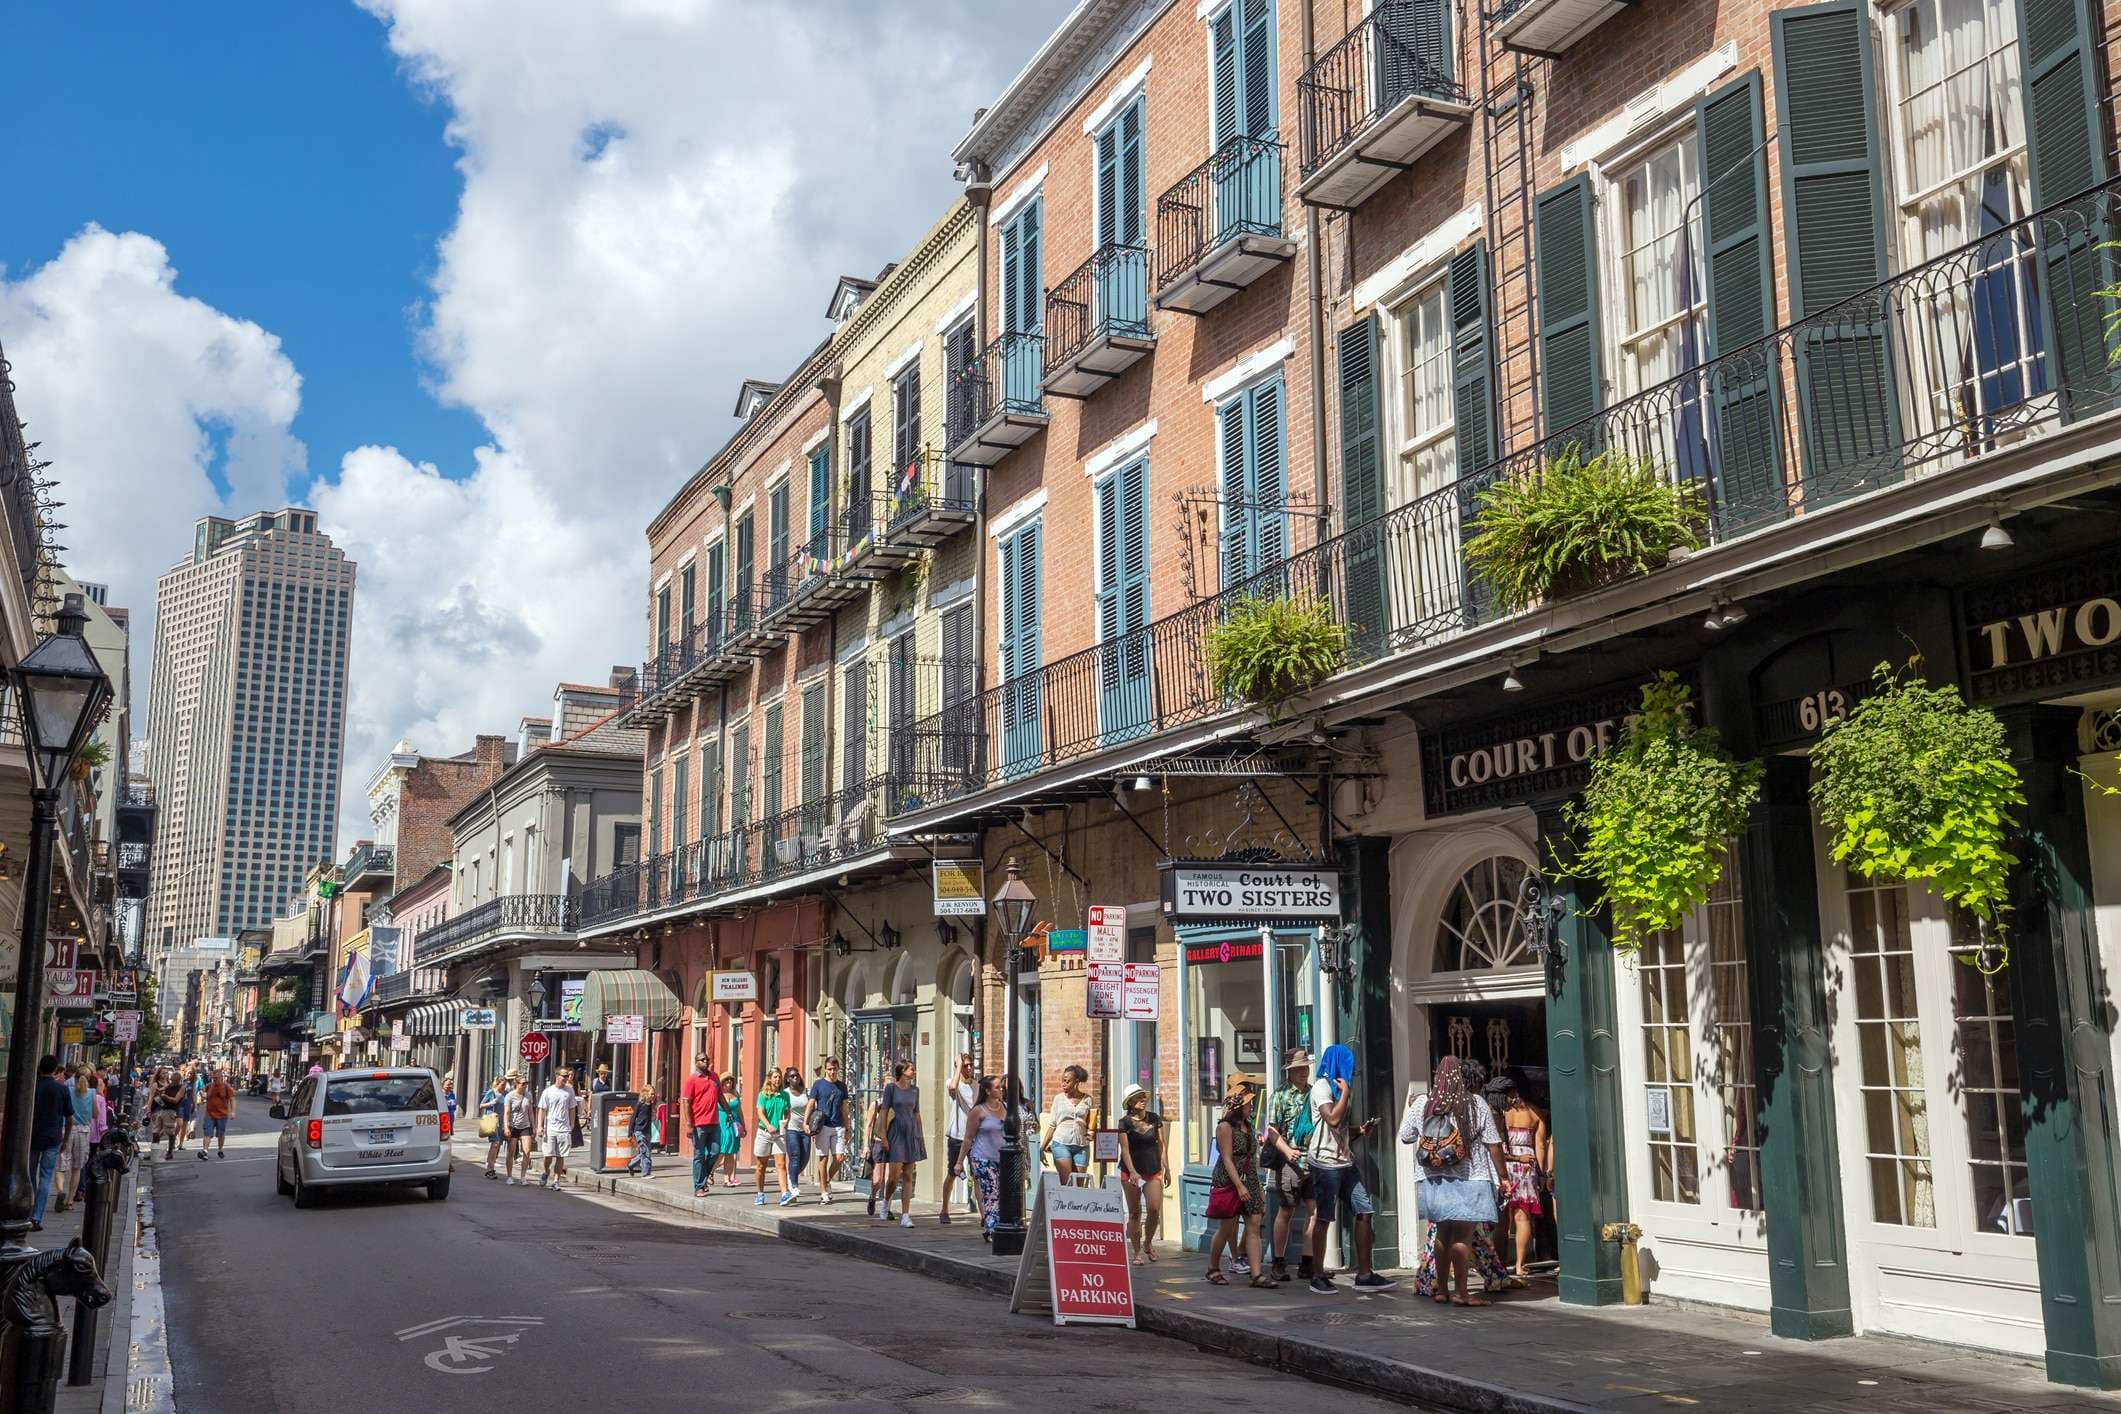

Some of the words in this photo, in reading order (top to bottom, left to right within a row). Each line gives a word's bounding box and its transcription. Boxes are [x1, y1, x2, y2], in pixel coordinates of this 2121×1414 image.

[1981, 597, 2121, 669] TWO
[1800, 691, 1846, 731] 613
[1450, 733, 1556, 787] COURT
[1567, 719, 1614, 762] OF
[1239, 873, 1293, 887] Court
[1301, 874, 1321, 890] of
[1183, 890, 1233, 906] TWO
[1242, 891, 1332, 907] SISTERS
[1091, 910, 1102, 922] NO
[1097, 927, 1115, 936] MALL
[1088, 967, 1098, 978] NO
[1090, 983, 1119, 991] FREIGHT
[1095, 991, 1114, 999] ZONE
[521, 1041, 548, 1053] STOP
[359, 1151, 382, 1159] White
[1053, 1228, 1123, 1242] PASSENGER
[1074, 1243, 1107, 1256] ZONE
[1082, 1274, 1104, 1287] NO
[1060, 1289, 1128, 1305] PARKING
